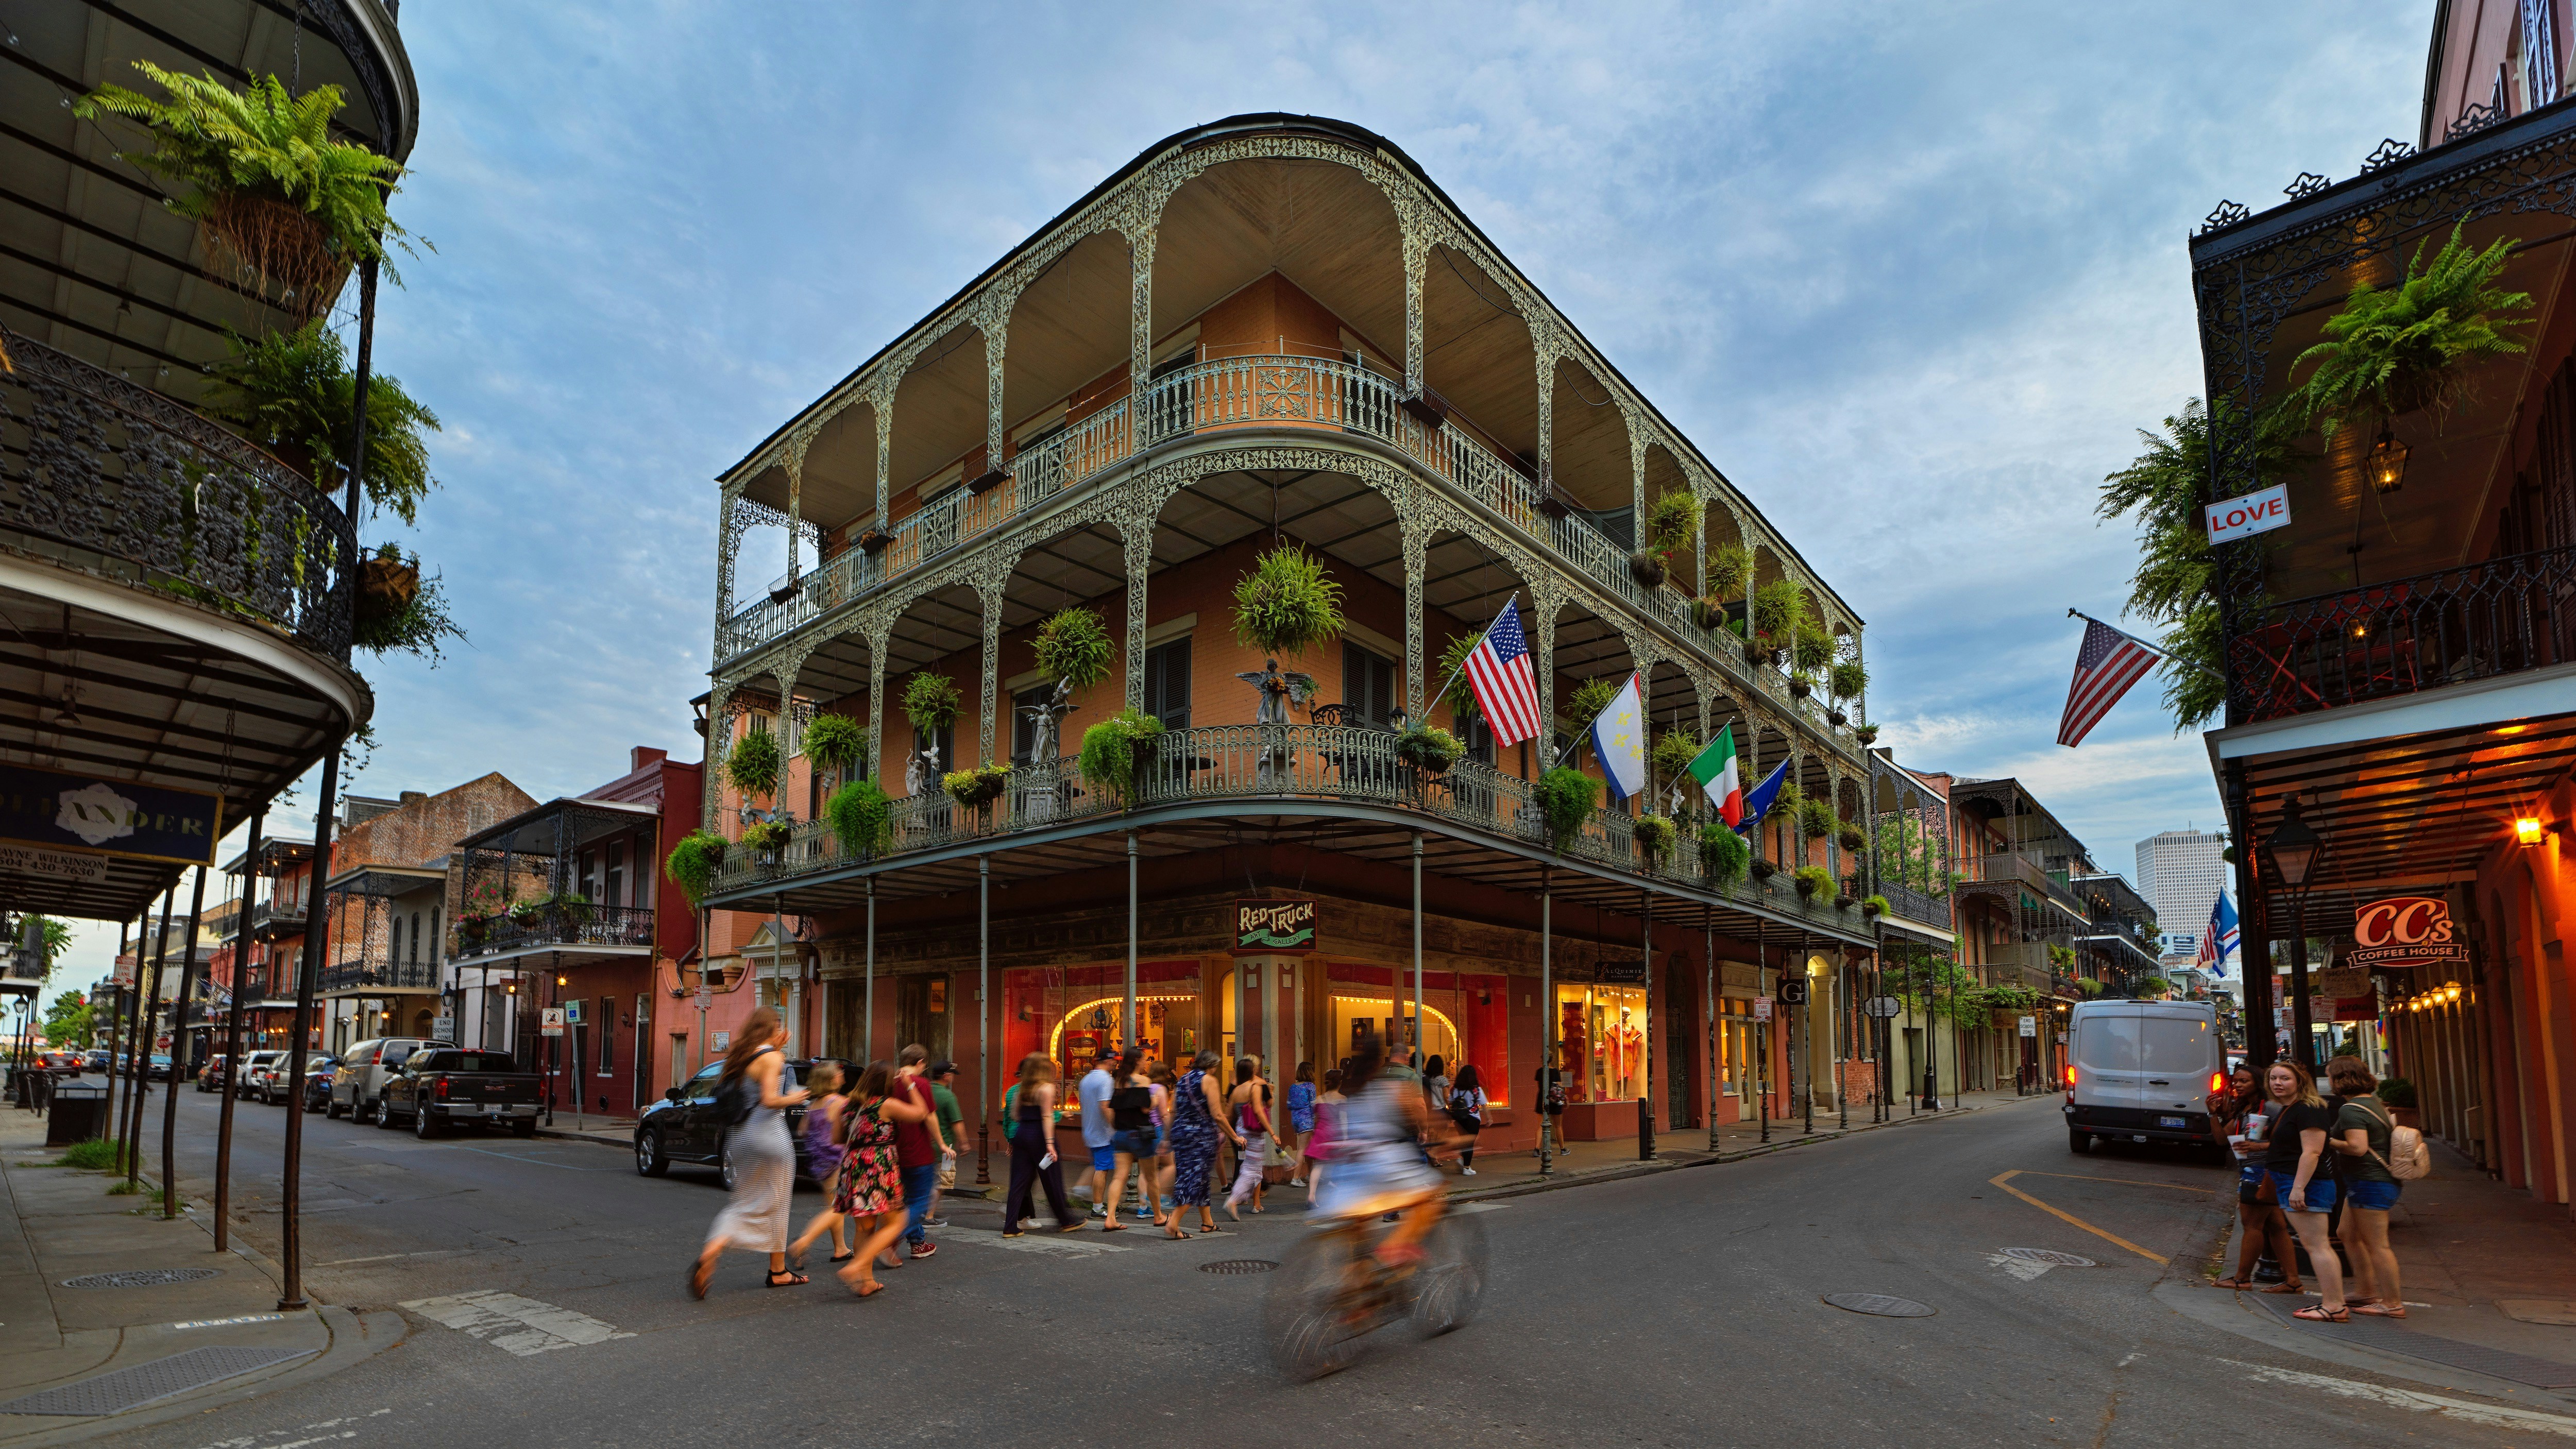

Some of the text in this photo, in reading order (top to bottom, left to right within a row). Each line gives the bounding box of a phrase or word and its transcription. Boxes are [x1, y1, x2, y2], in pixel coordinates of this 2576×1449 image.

[2212, 497, 2283, 532] LOVE
[0, 848, 105, 870] AYNE WILKINSON
[1239, 902, 1314, 933] RED TRUCK
[1250, 931, 1301, 945] ART GALLERY
[2358, 947, 2454, 961] COFFEE HOUSE
[1782, 983, 1805, 1002] G
